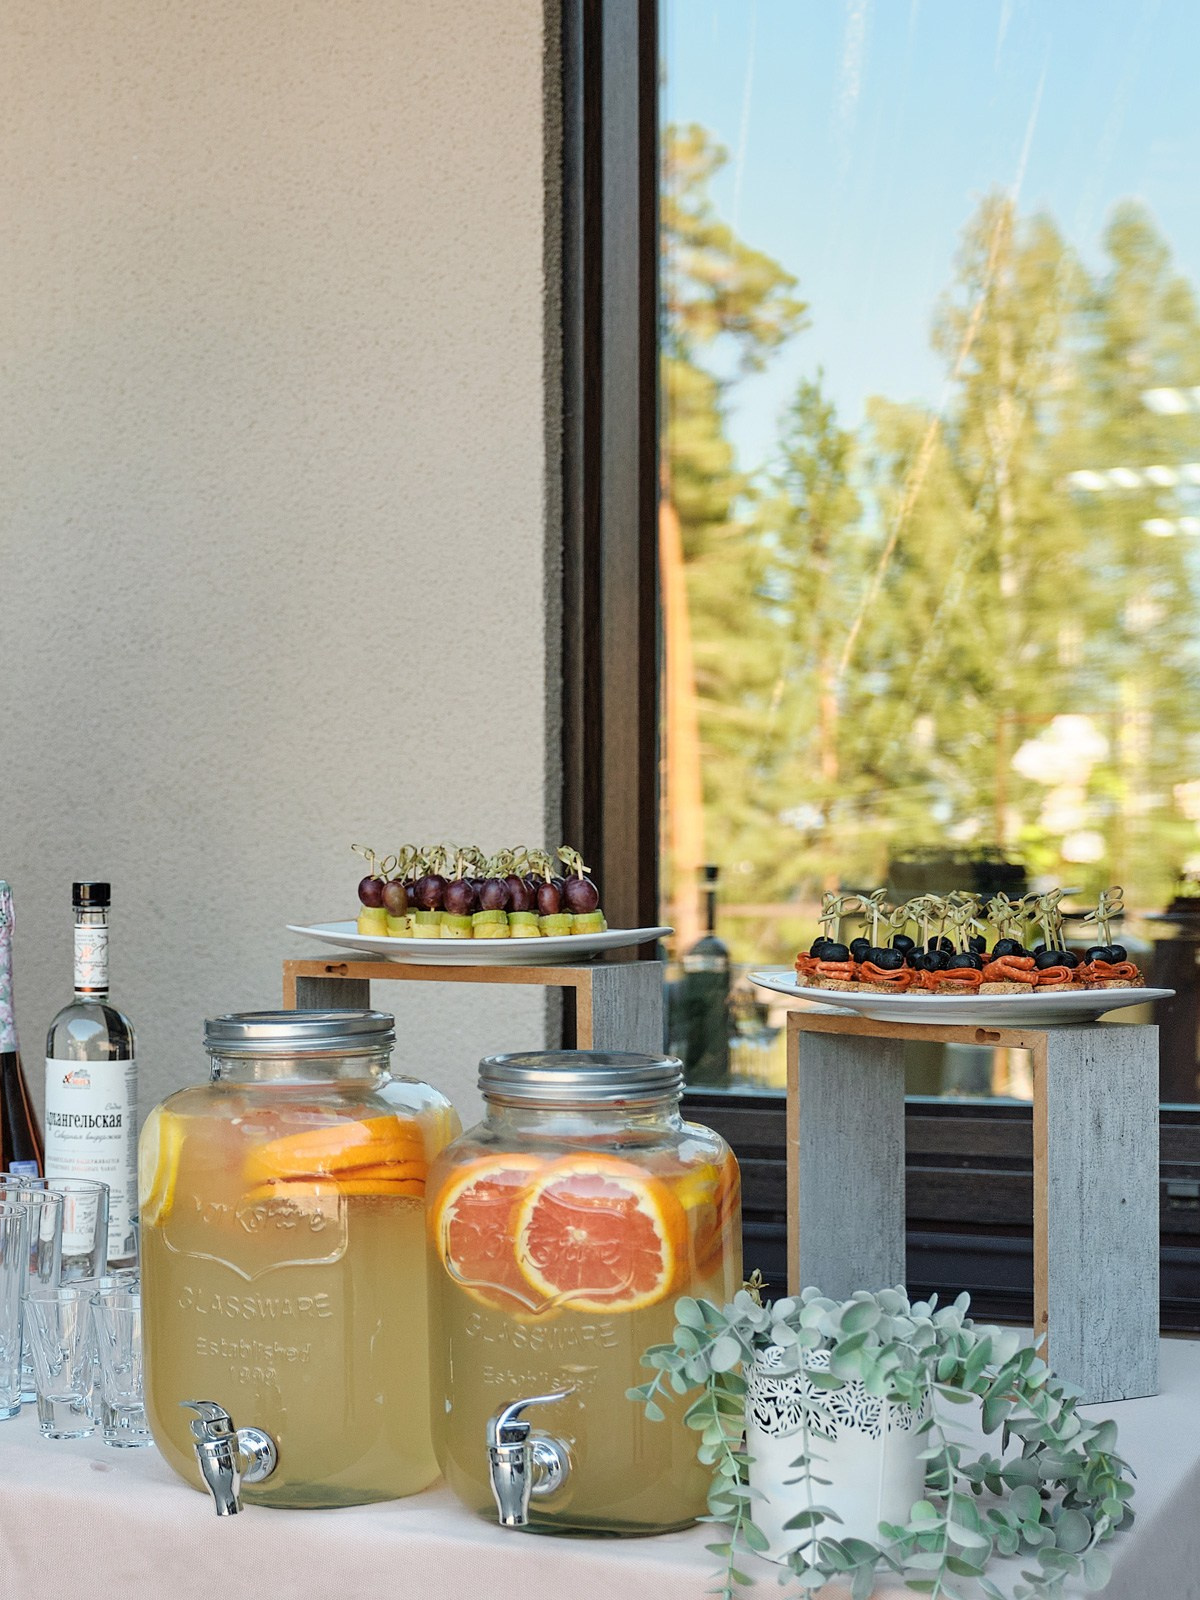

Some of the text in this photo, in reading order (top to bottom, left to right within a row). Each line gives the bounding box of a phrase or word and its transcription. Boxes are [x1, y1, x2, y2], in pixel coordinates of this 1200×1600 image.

[178, 1286, 334, 1320] GLASSWARE
[465, 1312, 619, 1350] GLASSWARE
[196, 1337, 313, 1362] Established
